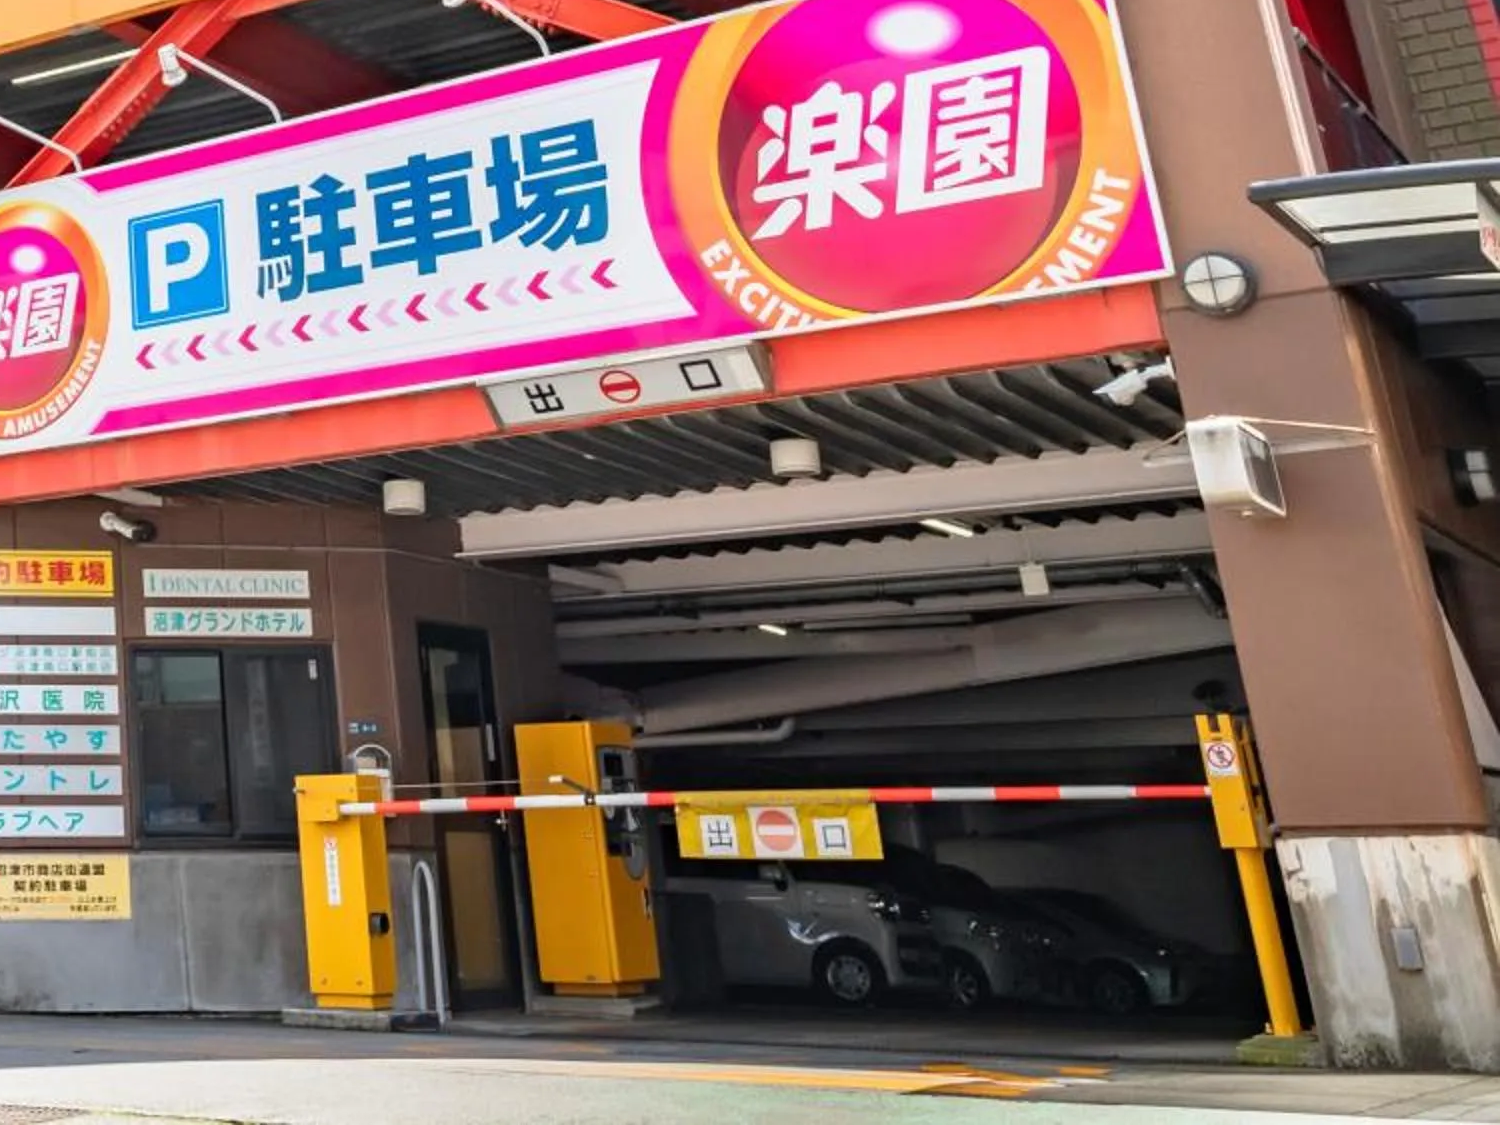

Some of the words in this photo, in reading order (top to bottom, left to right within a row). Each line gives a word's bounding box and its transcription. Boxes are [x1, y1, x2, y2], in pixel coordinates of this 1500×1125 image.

[750, 45, 1051, 241] 楽園
[256, 118, 609, 303] 駐車場
[144, 220, 211, 313] P
[3, 339, 102, 437] AMUSEMENT
[239, 578, 305, 594] CLINIC
